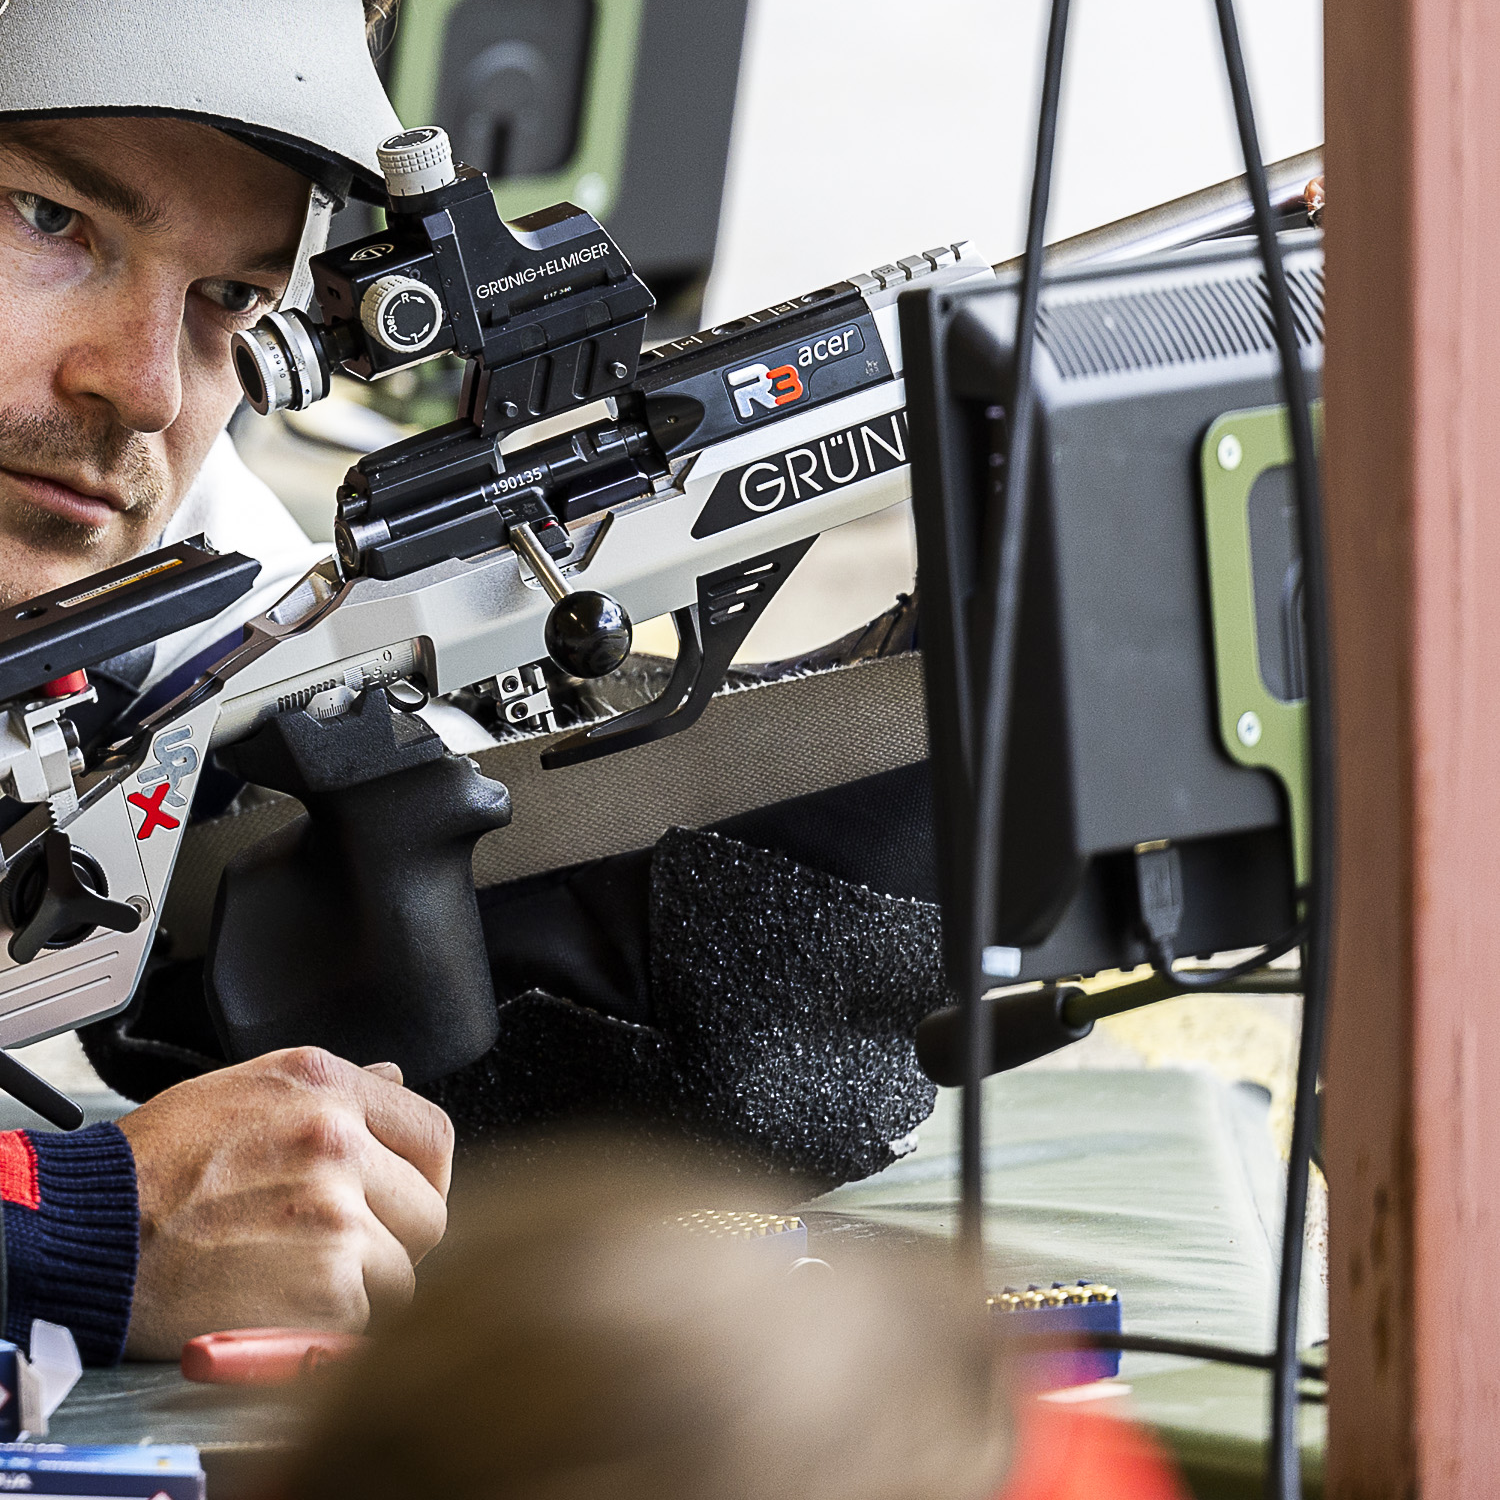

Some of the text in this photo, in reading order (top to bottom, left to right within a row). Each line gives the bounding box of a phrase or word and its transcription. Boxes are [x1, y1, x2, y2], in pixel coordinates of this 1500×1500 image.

[476, 242, 610, 299] GRÜNIG+ELMIGER
[798, 329, 854, 367] acer
[491, 467, 543, 496] 190135
[739, 411, 909, 512] GRÜN
